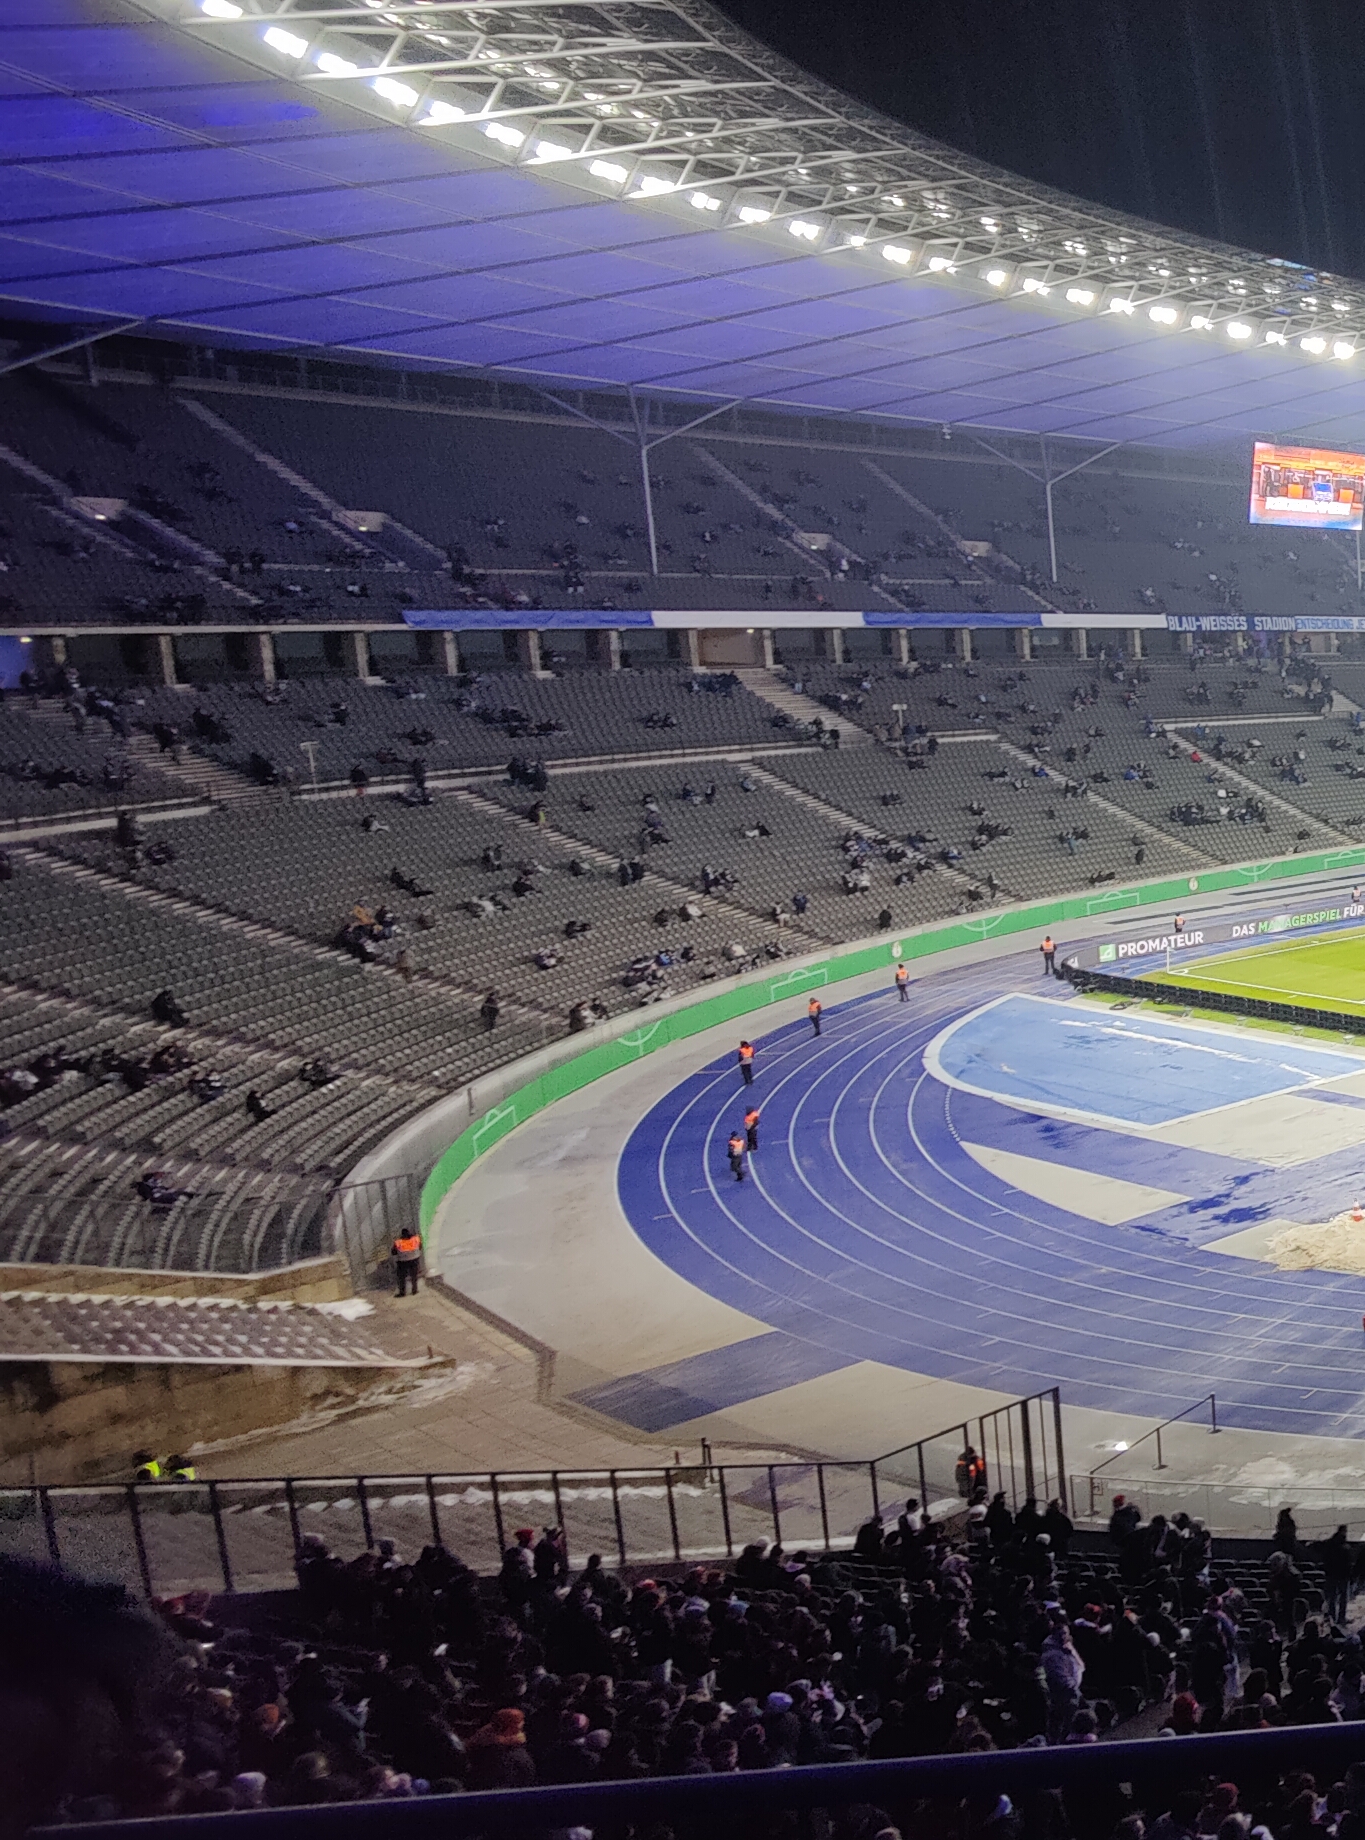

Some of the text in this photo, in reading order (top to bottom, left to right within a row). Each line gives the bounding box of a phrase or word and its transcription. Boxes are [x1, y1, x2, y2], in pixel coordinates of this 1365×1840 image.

[1167, 615, 1296, 632] BLAU-WEISSES STADION
[1232, 923, 1256, 938] DAS
[1343, 902, 1365, 919] FÜR
[1118, 930, 1204, 958] PROMATEUR
